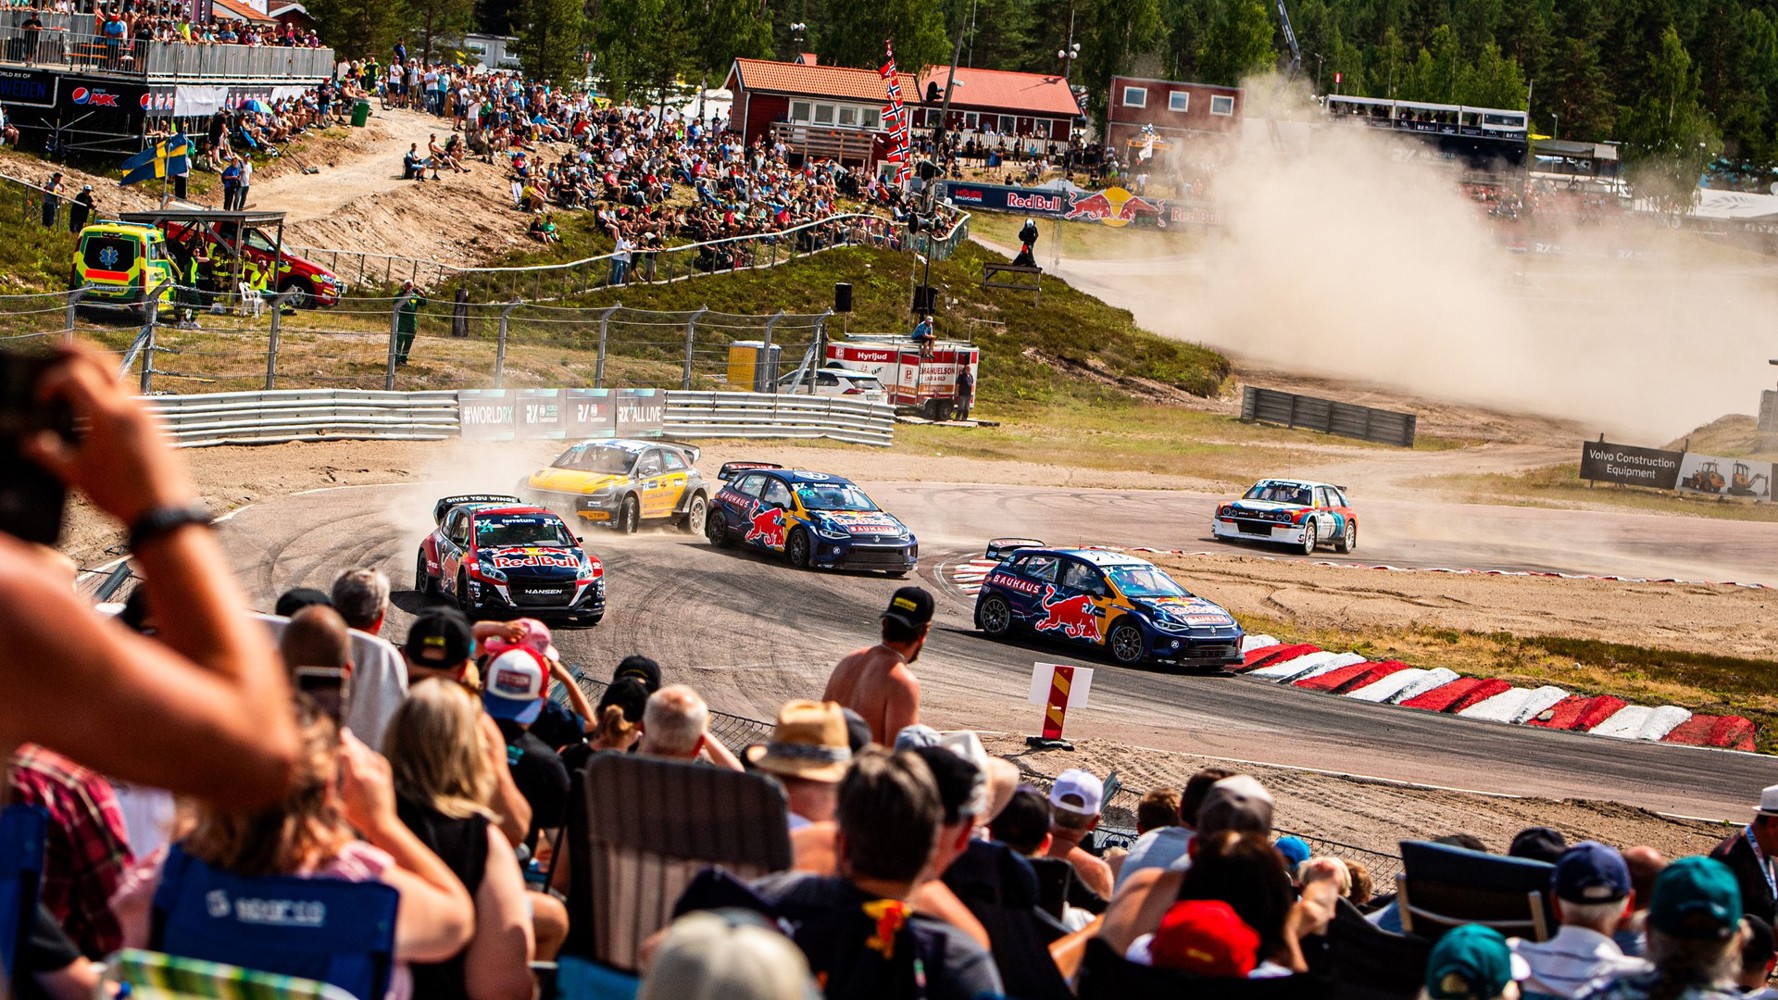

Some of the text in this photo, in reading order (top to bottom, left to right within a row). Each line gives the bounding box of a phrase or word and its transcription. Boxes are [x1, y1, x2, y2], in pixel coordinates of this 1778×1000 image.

[1007, 192, 1061, 211] Red Bull
[1171, 207, 1197, 222] Red
[464, 406, 513, 424] #WORLDRX
[526, 405, 540, 424] RX
[632, 406, 645, 422] ALL
[646, 406, 661, 422] LIVE
[1590, 449, 1676, 469] Volvo Construction
[1606, 464, 1656, 479] Equipment
[720, 490, 750, 508] BAUHAUS
[493, 554, 580, 569] Red Bull
[993, 574, 1041, 594] BAUHAUS
